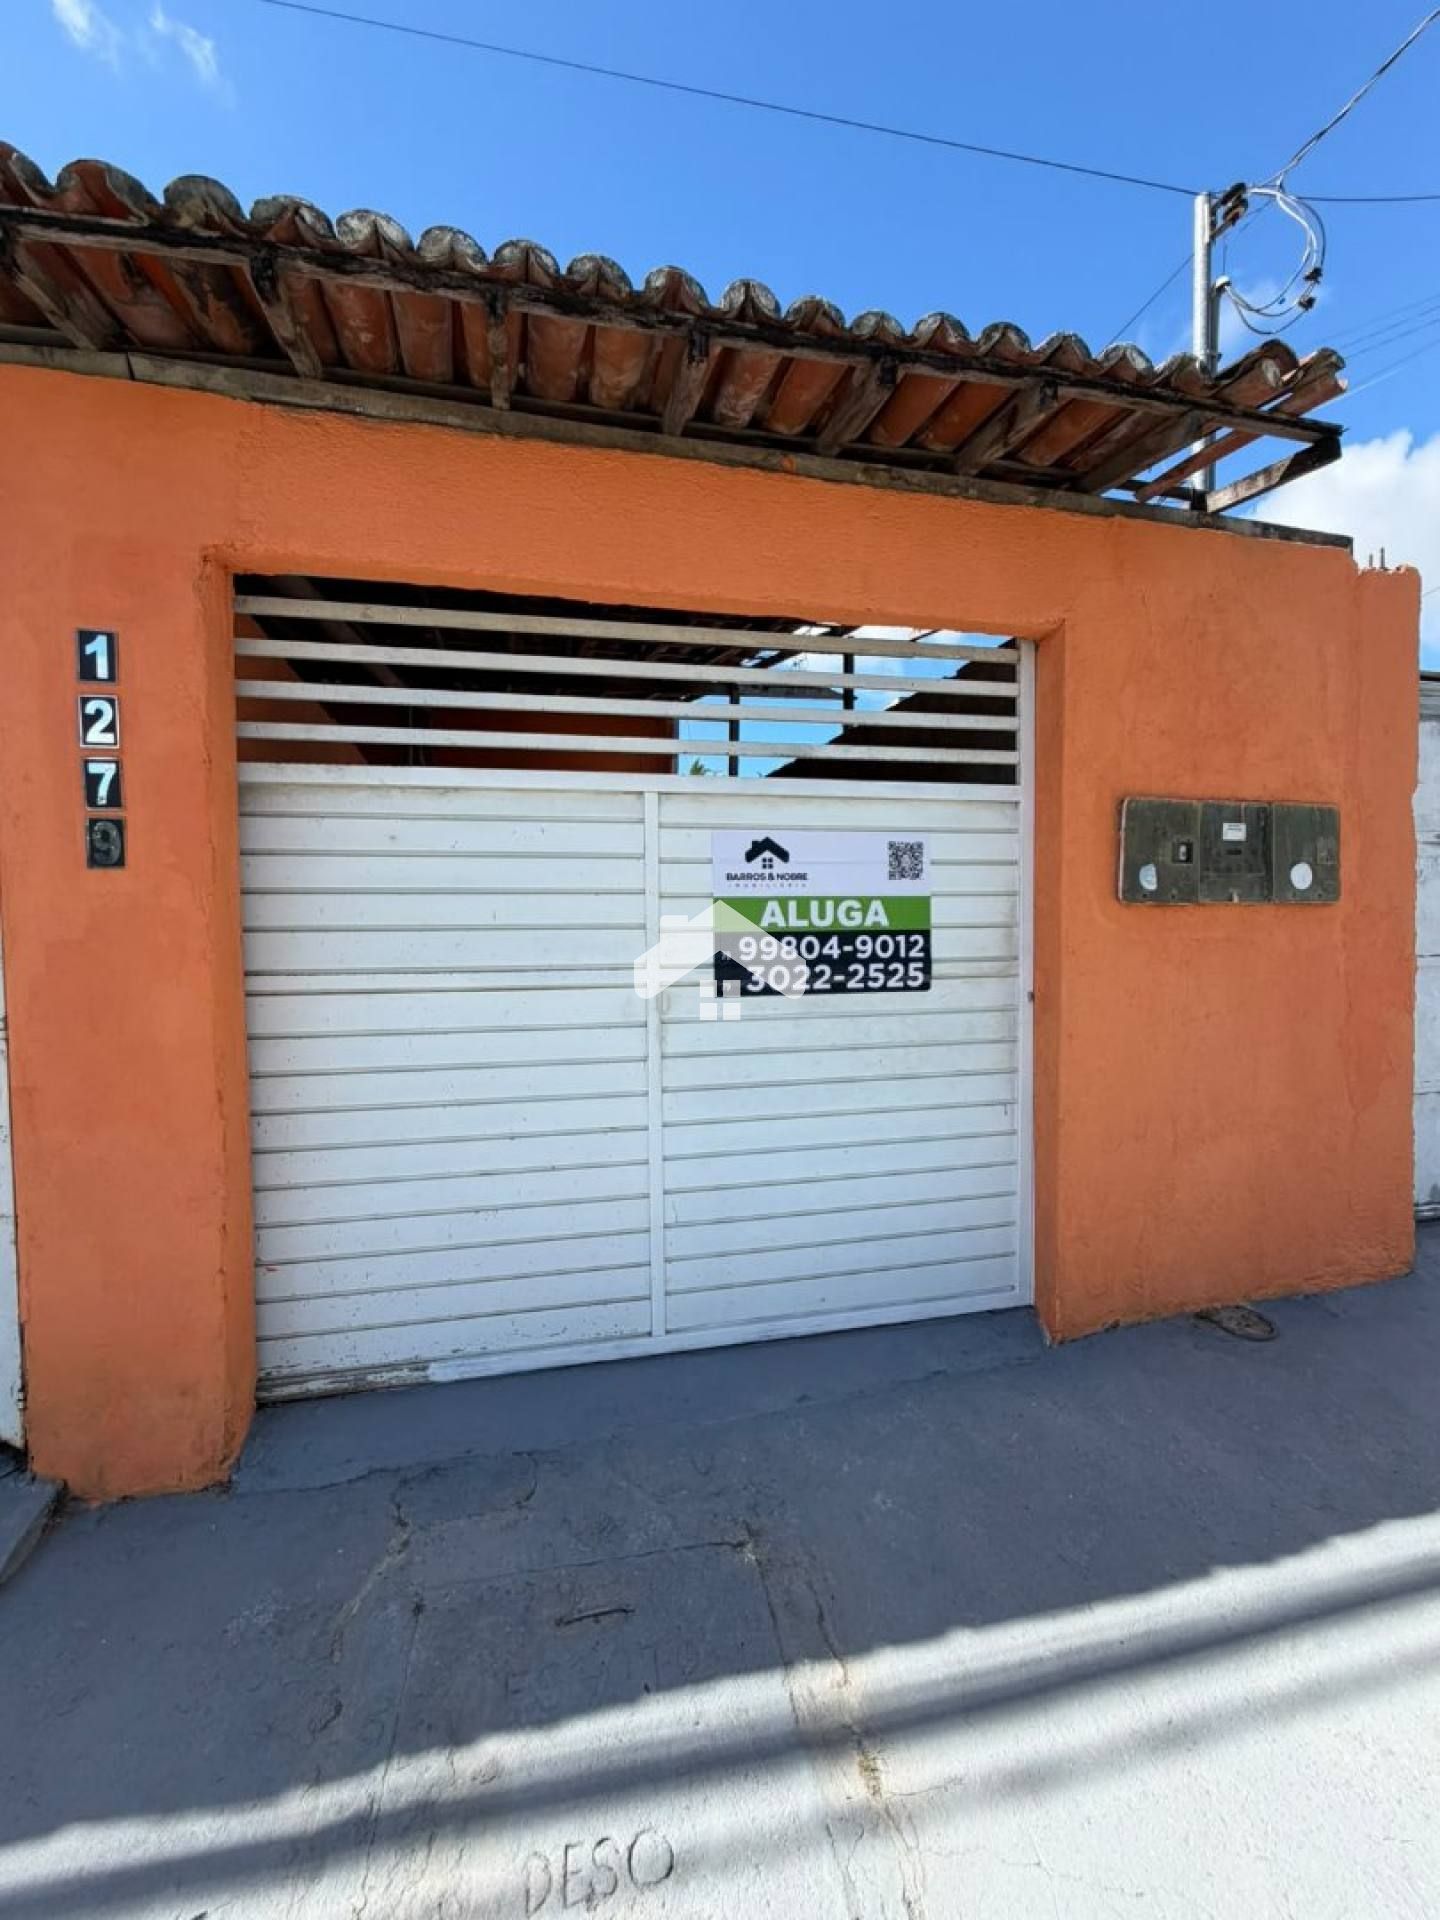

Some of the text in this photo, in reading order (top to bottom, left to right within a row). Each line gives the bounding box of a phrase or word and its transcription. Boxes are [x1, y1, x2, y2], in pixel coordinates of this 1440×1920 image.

[726, 872, 808, 881] BARROS & NOBRE
[760, 899, 890, 927] ALUGA
[739, 934, 924, 961] 99804-9012
[747, 962, 924, 992] 3022-2525
[524, 1828, 675, 1919] DESO
